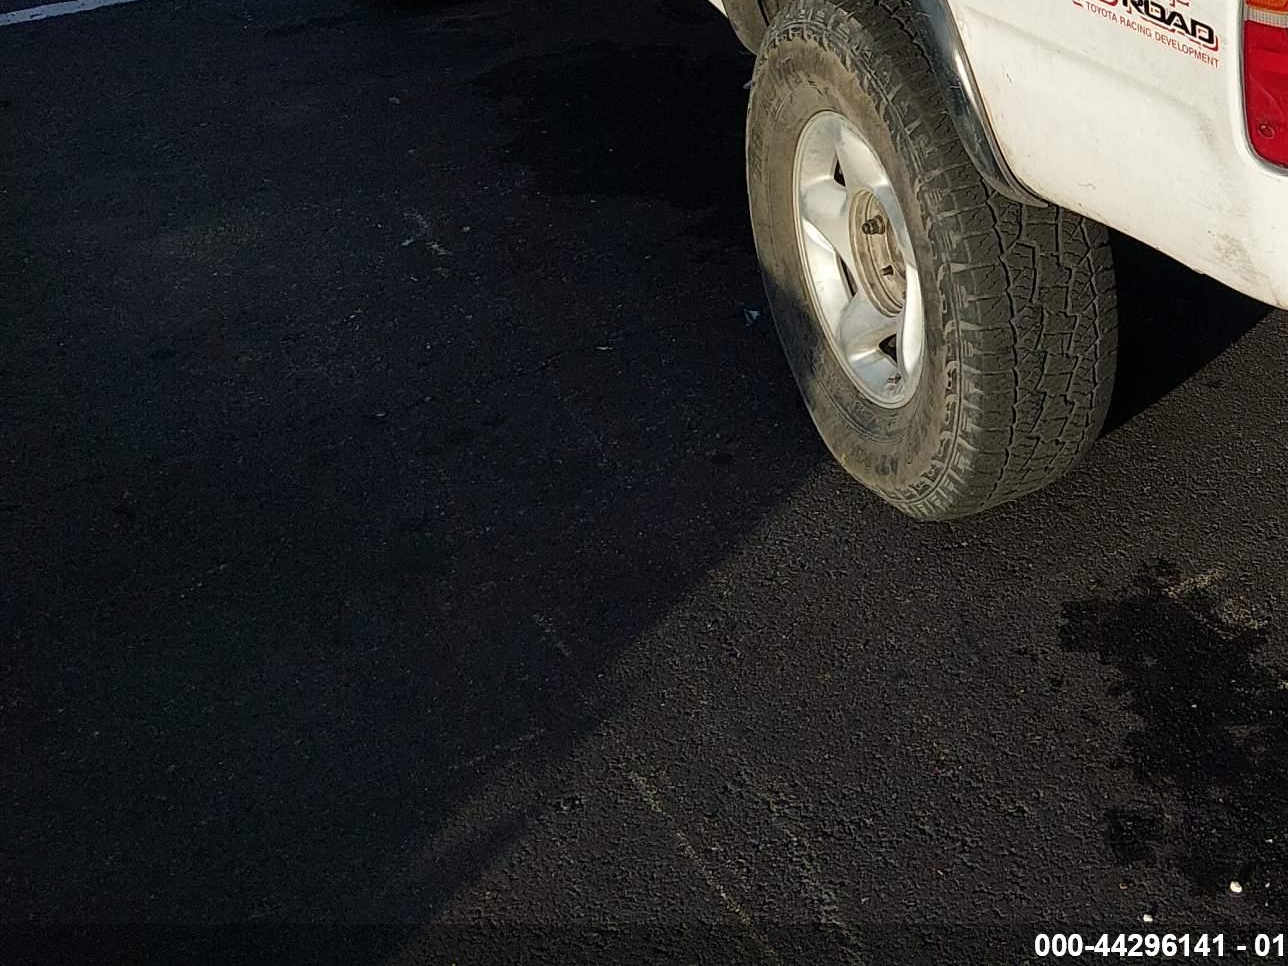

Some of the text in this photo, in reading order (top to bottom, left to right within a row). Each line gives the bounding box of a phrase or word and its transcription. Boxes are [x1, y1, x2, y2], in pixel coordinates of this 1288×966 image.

[1085, 1, 1220, 69] TOYOTA RACING DEVELOPMENT
